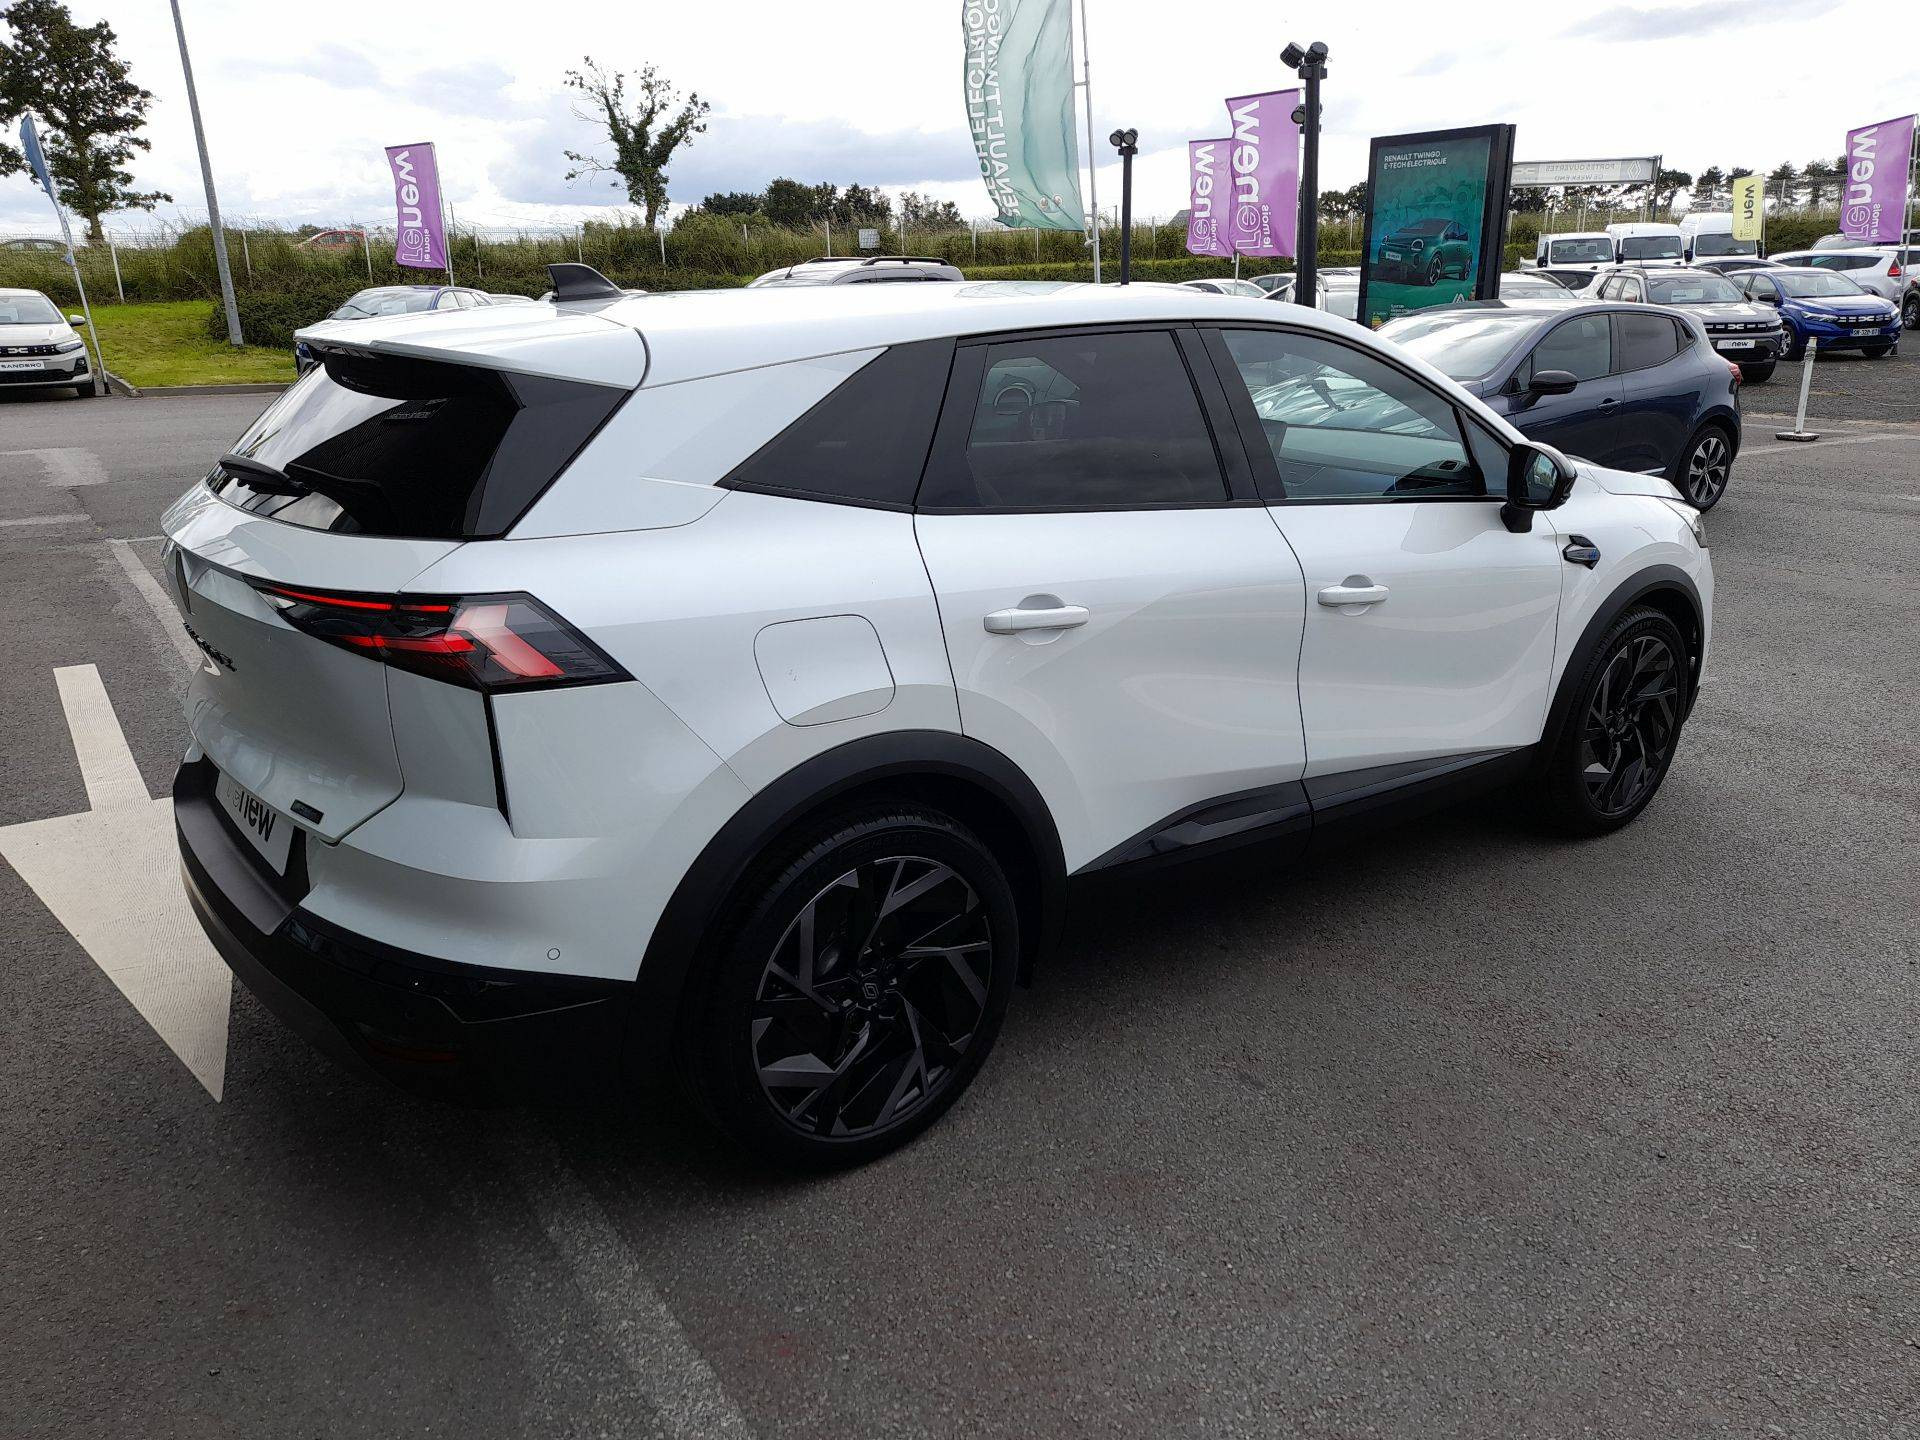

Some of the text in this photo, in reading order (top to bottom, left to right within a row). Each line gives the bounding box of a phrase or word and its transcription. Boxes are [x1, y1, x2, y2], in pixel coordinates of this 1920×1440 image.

[1384, 150, 1441, 162] RENAULT TWINGO
[1383, 161, 1407, 169] E-TECH
